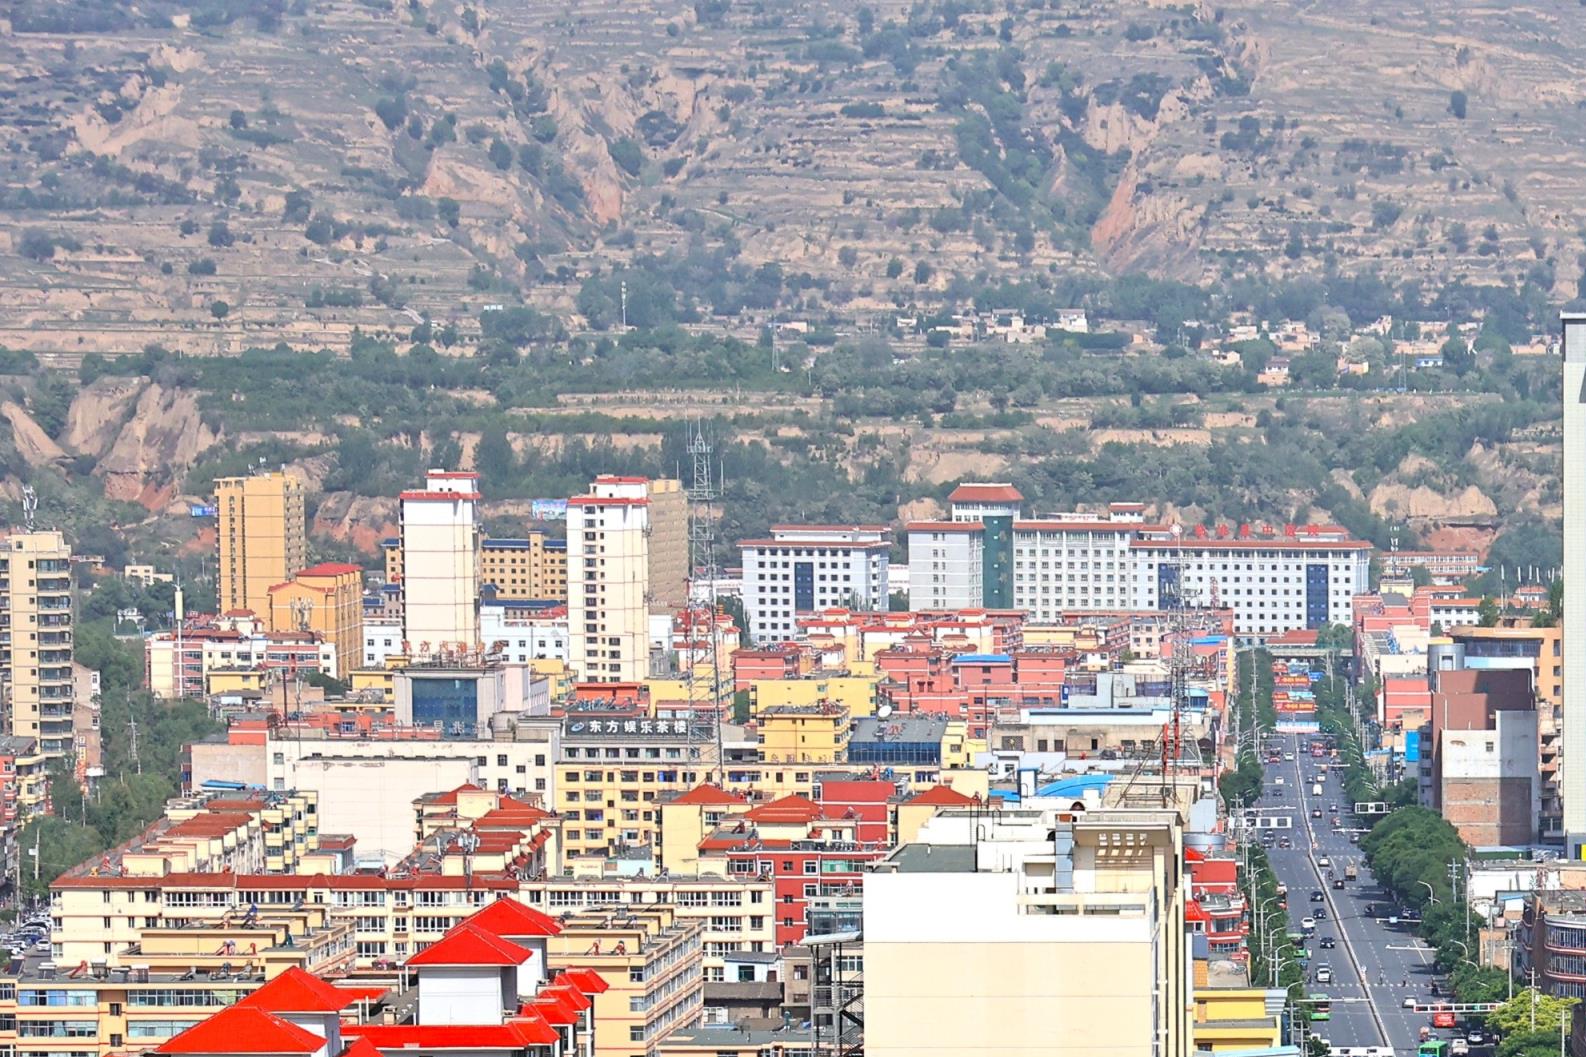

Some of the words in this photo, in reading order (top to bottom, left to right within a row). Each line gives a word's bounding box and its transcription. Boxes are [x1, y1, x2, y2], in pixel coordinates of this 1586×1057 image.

[589, 719, 687, 734] 东方娱乐茶楼
